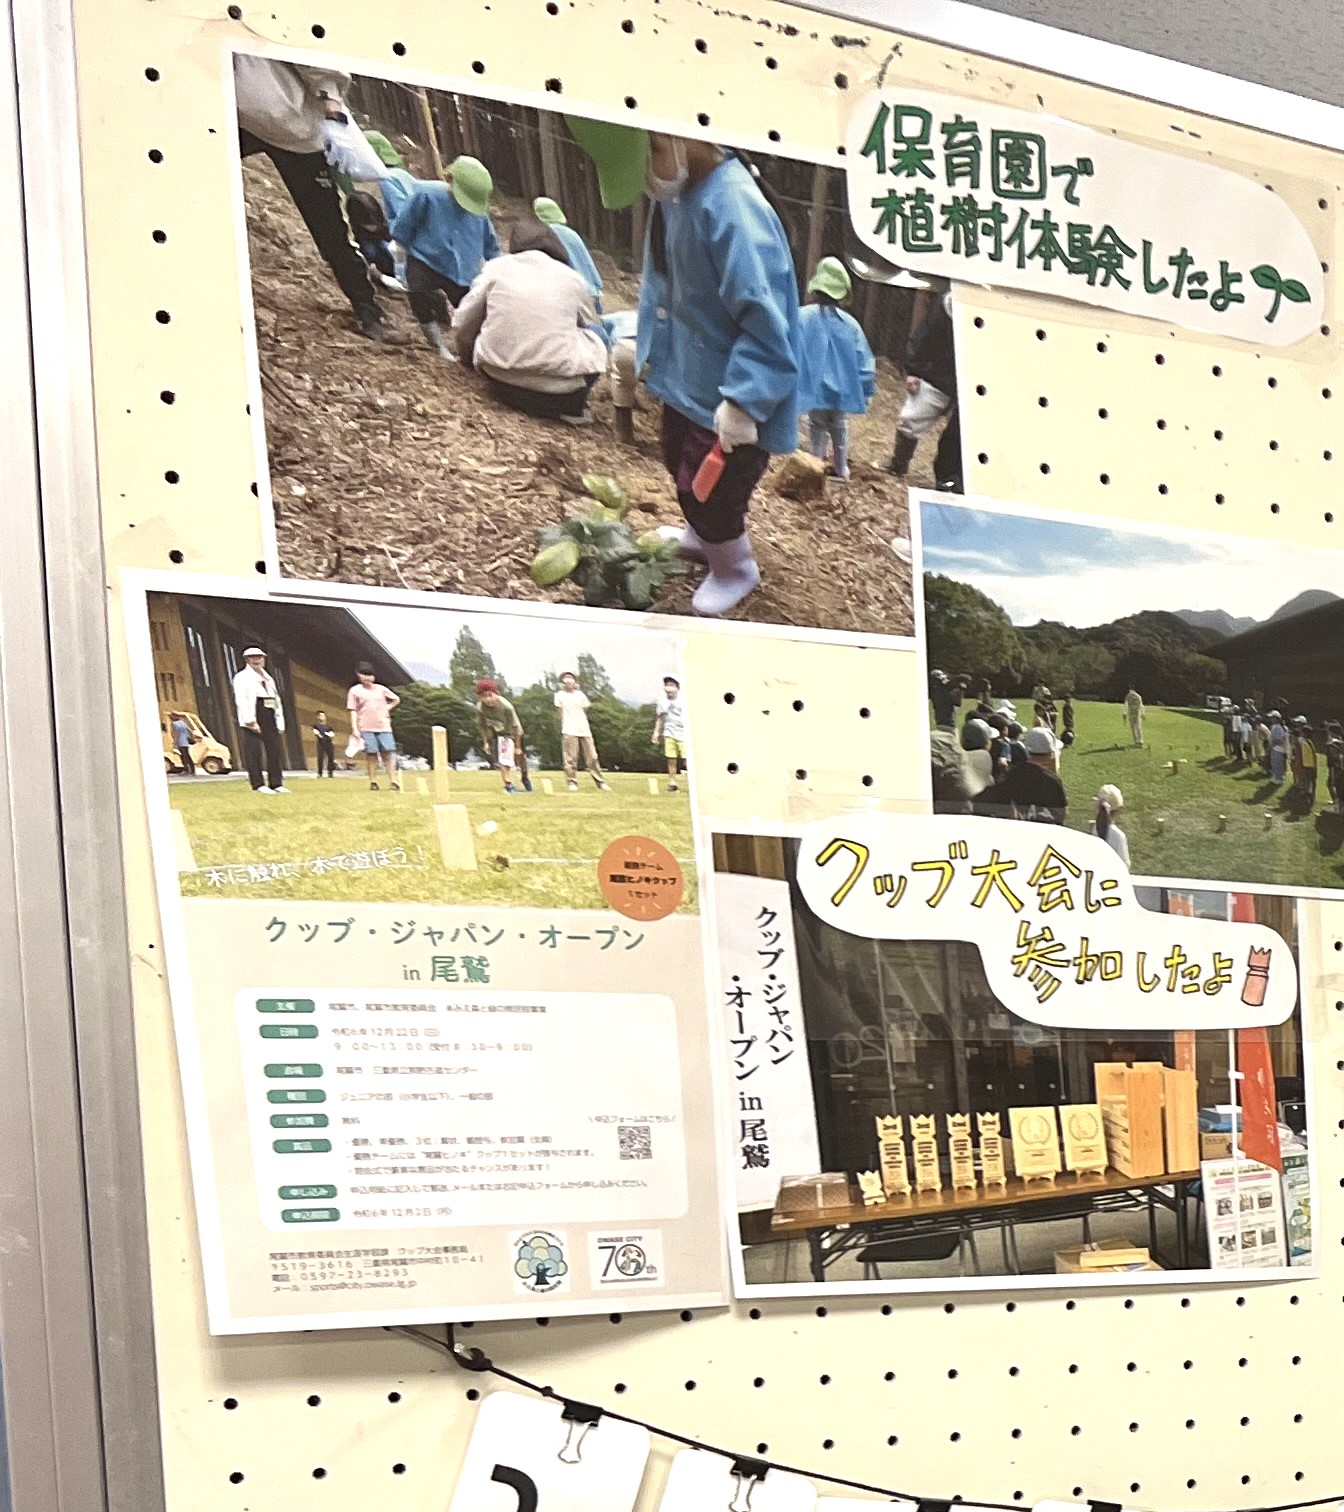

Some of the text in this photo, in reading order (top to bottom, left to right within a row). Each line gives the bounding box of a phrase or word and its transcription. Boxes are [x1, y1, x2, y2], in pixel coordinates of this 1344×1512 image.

[861, 102, 1094, 205] 保育園で
[871, 190, 1245, 311] 植樹体験したよ
[403, 956, 491, 983] in 尾鷲
[1011, 920, 1234, 1003] 参加したよ
[739, 1092, 763, 1111] in
[739, 1118, 770, 1170] 尾鷲
